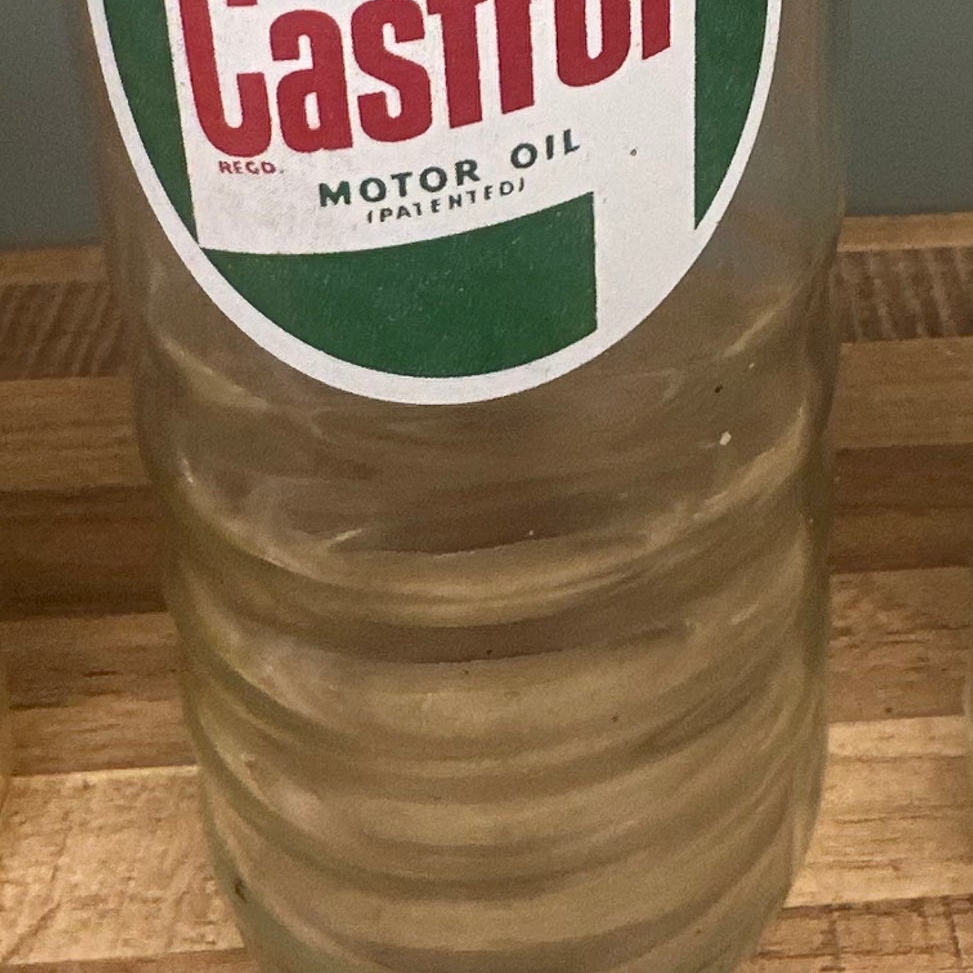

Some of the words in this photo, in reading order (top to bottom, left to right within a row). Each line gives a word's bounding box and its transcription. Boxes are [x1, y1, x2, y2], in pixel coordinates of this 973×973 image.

[319, 158, 482, 208] MOTOR
[510, 129, 581, 169] OIL
[367, 177, 526, 224] (PATENTED)
